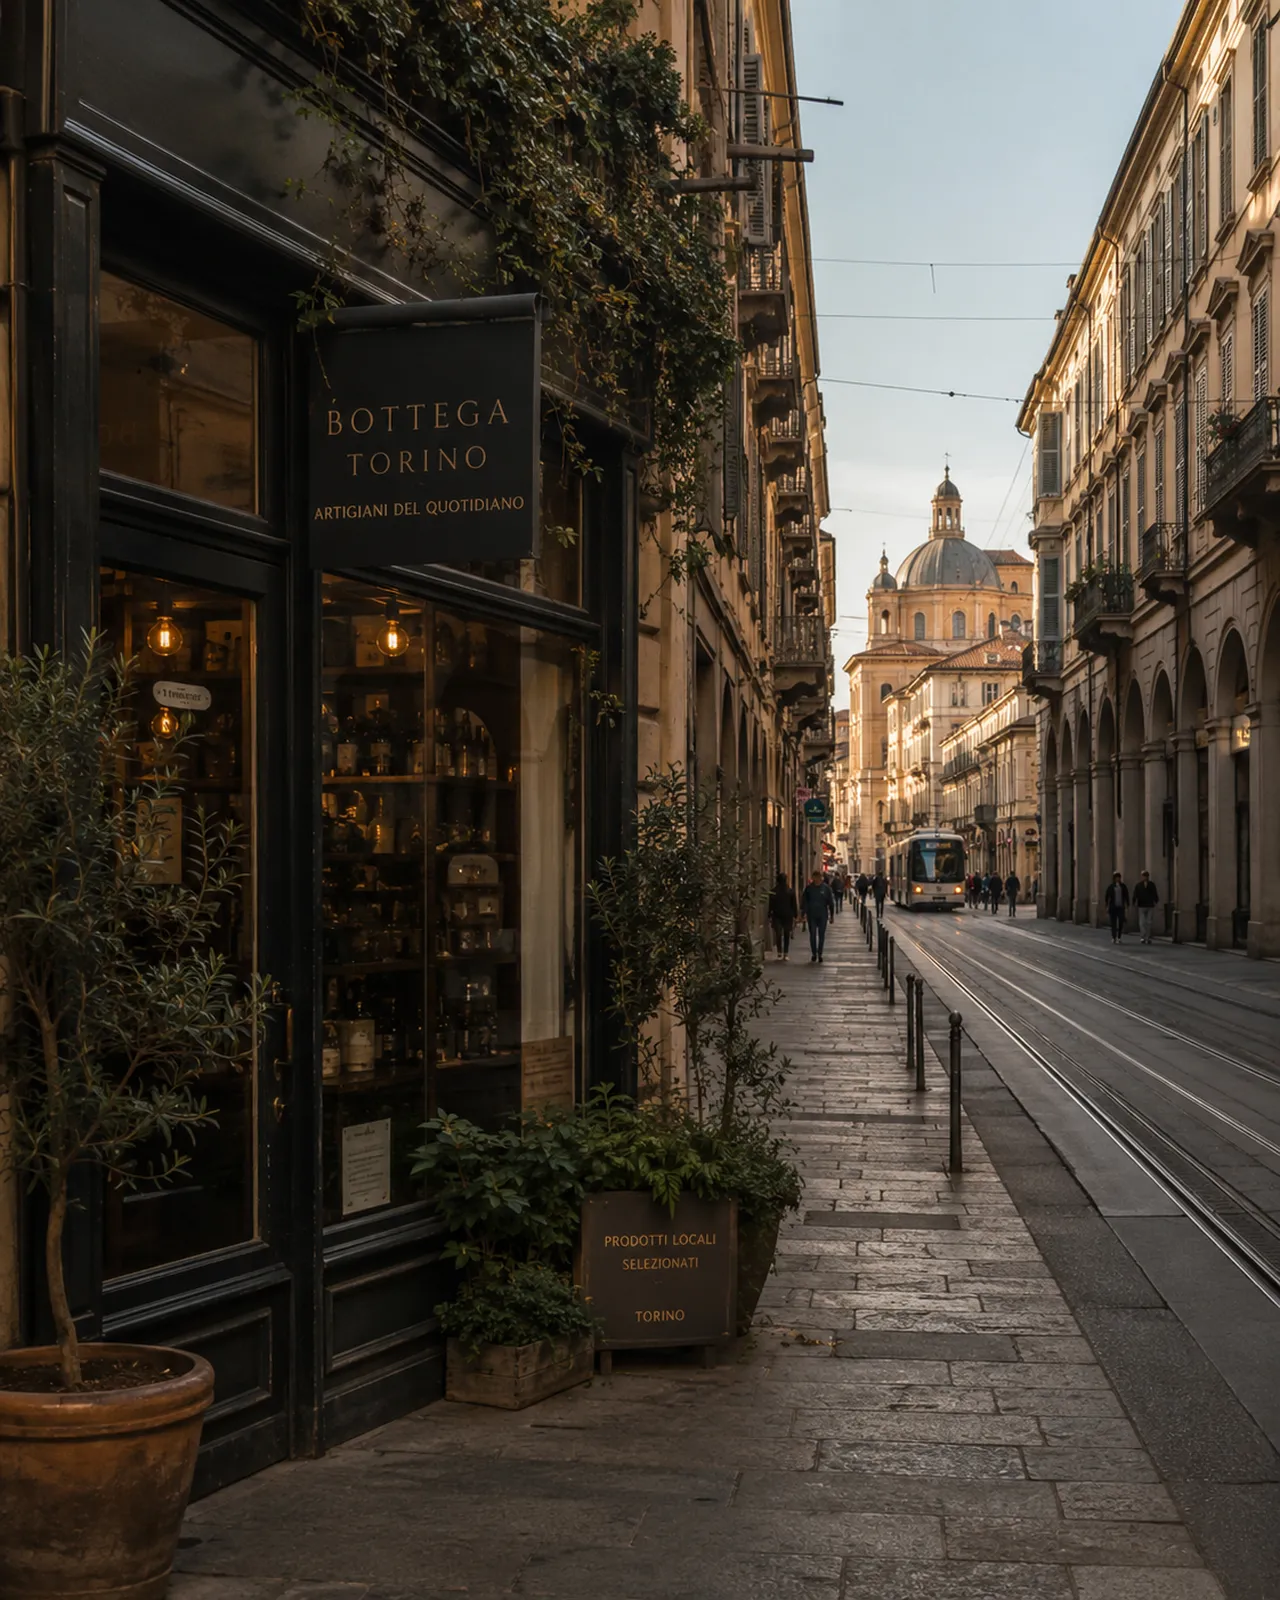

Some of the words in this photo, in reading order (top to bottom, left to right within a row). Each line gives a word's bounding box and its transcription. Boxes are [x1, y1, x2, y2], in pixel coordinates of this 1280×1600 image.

[327, 399, 509, 435] BOTTEGA
[347, 446, 487, 476] TORINO
[314, 505, 388, 520] ARTIGIANI
[393, 502, 420, 516] DEL
[425, 496, 525, 515] QUOTIDIANO
[604, 1234, 667, 1247] PRODOTTI
[672, 1233, 716, 1246] LOCALI
[622, 1257, 699, 1270] SELEZIONATI
[635, 1309, 685, 1322] TORINO
